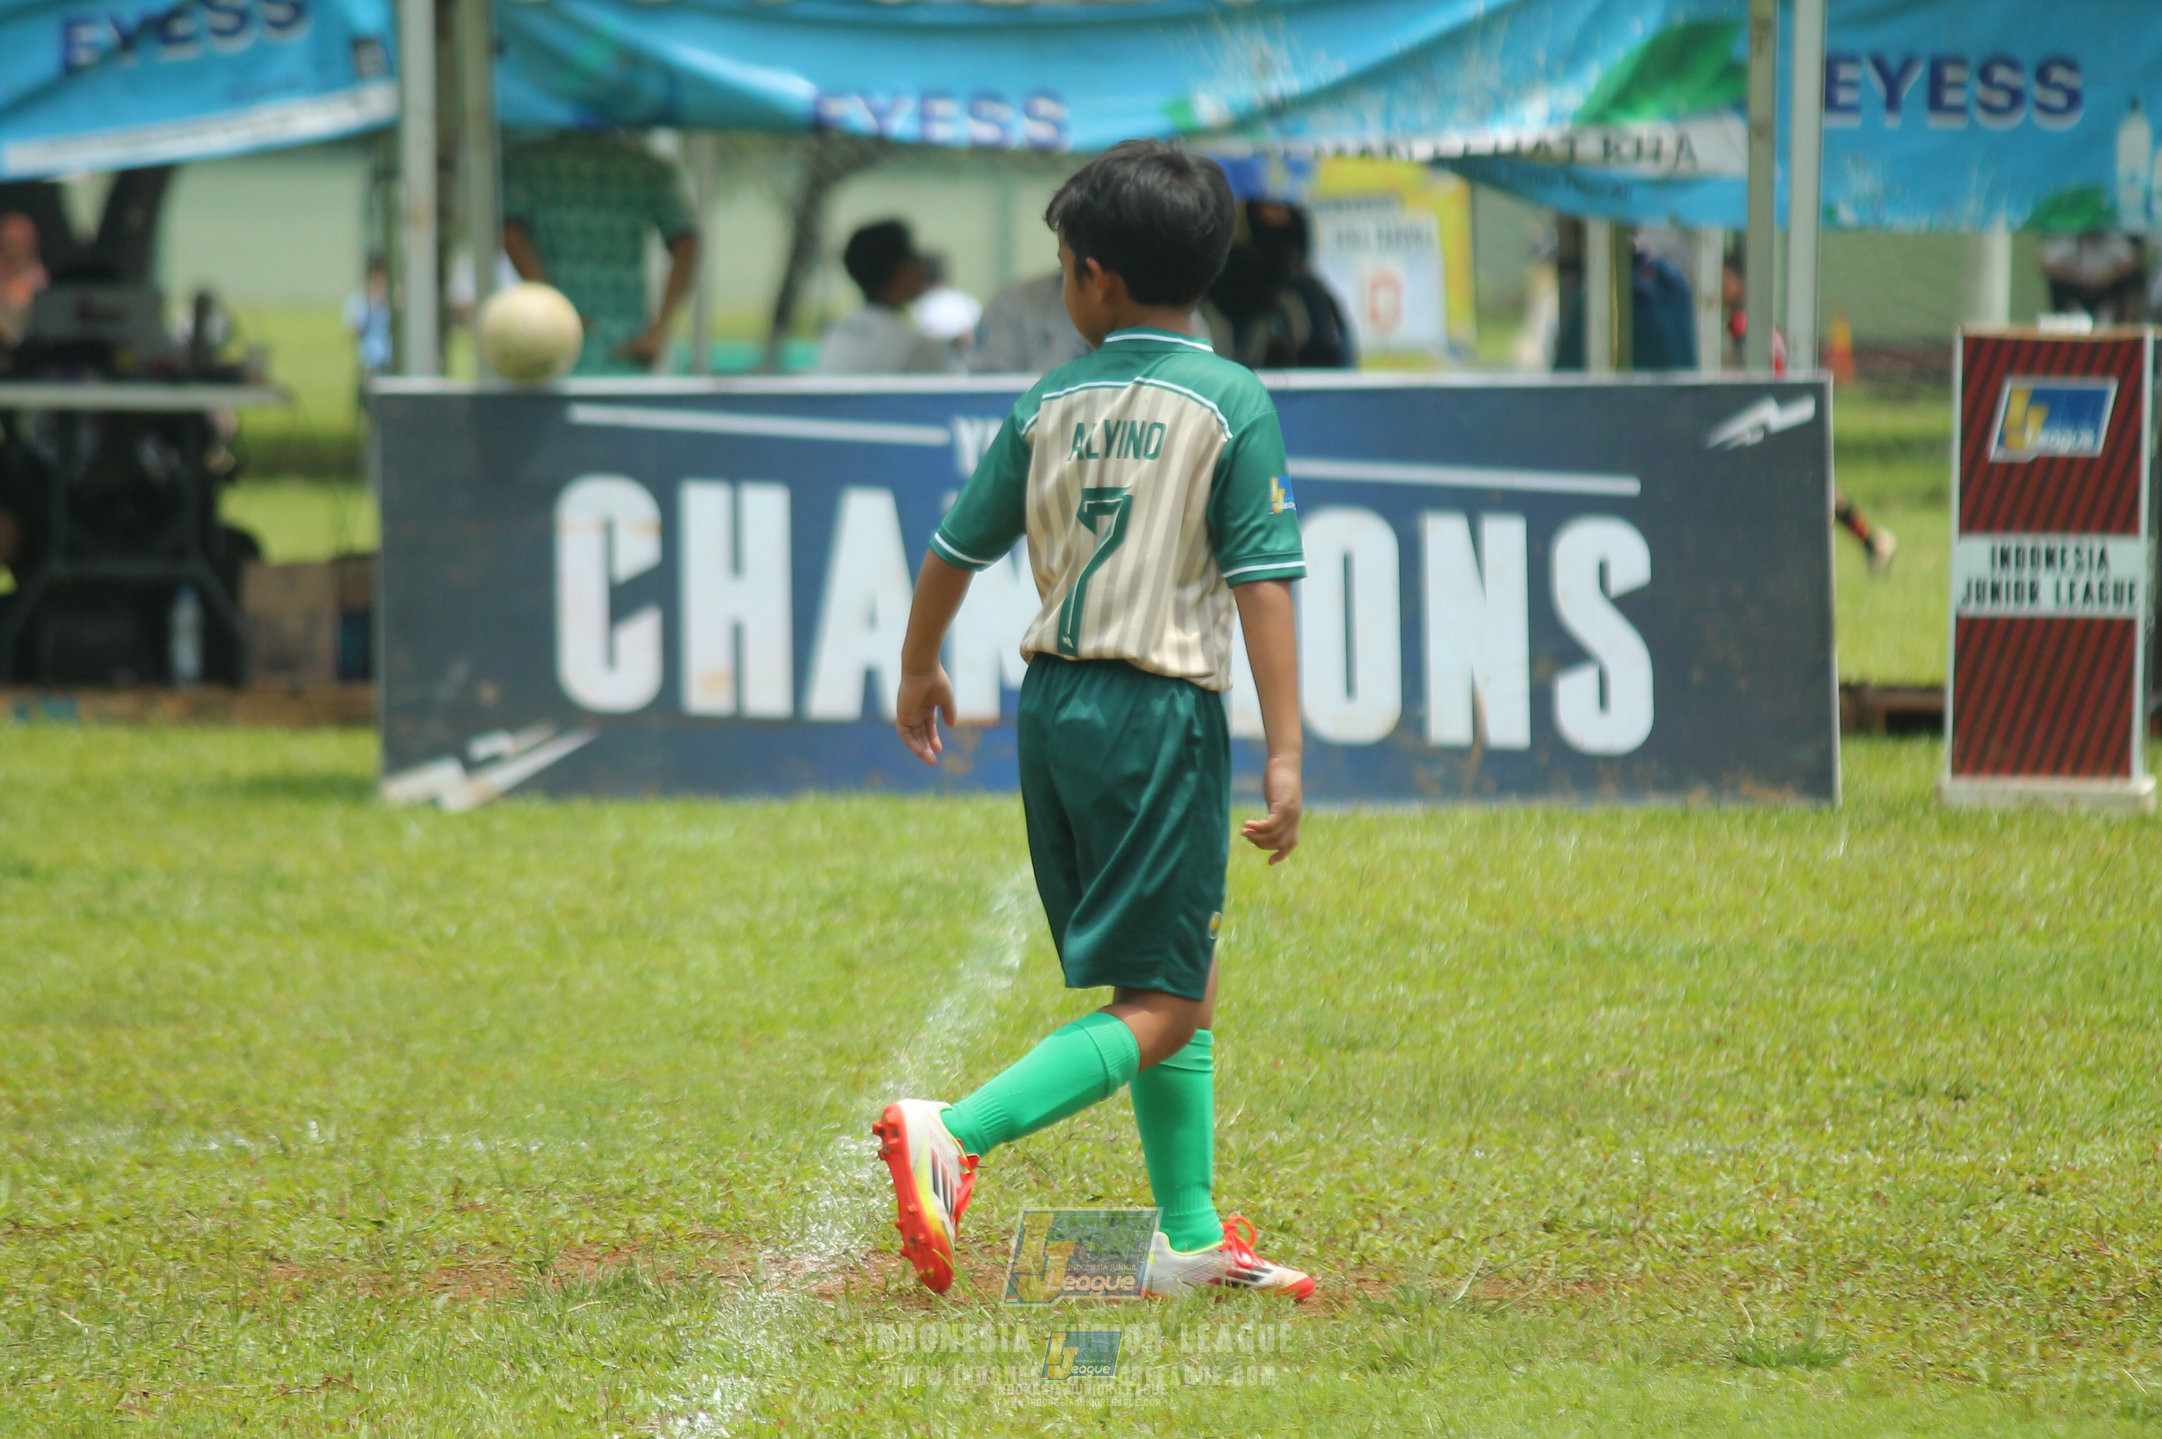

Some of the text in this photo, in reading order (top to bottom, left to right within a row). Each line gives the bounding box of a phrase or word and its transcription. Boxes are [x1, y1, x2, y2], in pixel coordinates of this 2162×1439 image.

[1824, 54, 2084, 131] EYESS
[1057, 487, 1134, 656] 7
[1963, 577, 2138, 606] JUNIOR LEAGUE
[1990, 544, 2111, 571] INDONESIA
[554, 472, 1656, 757] CHAONS
